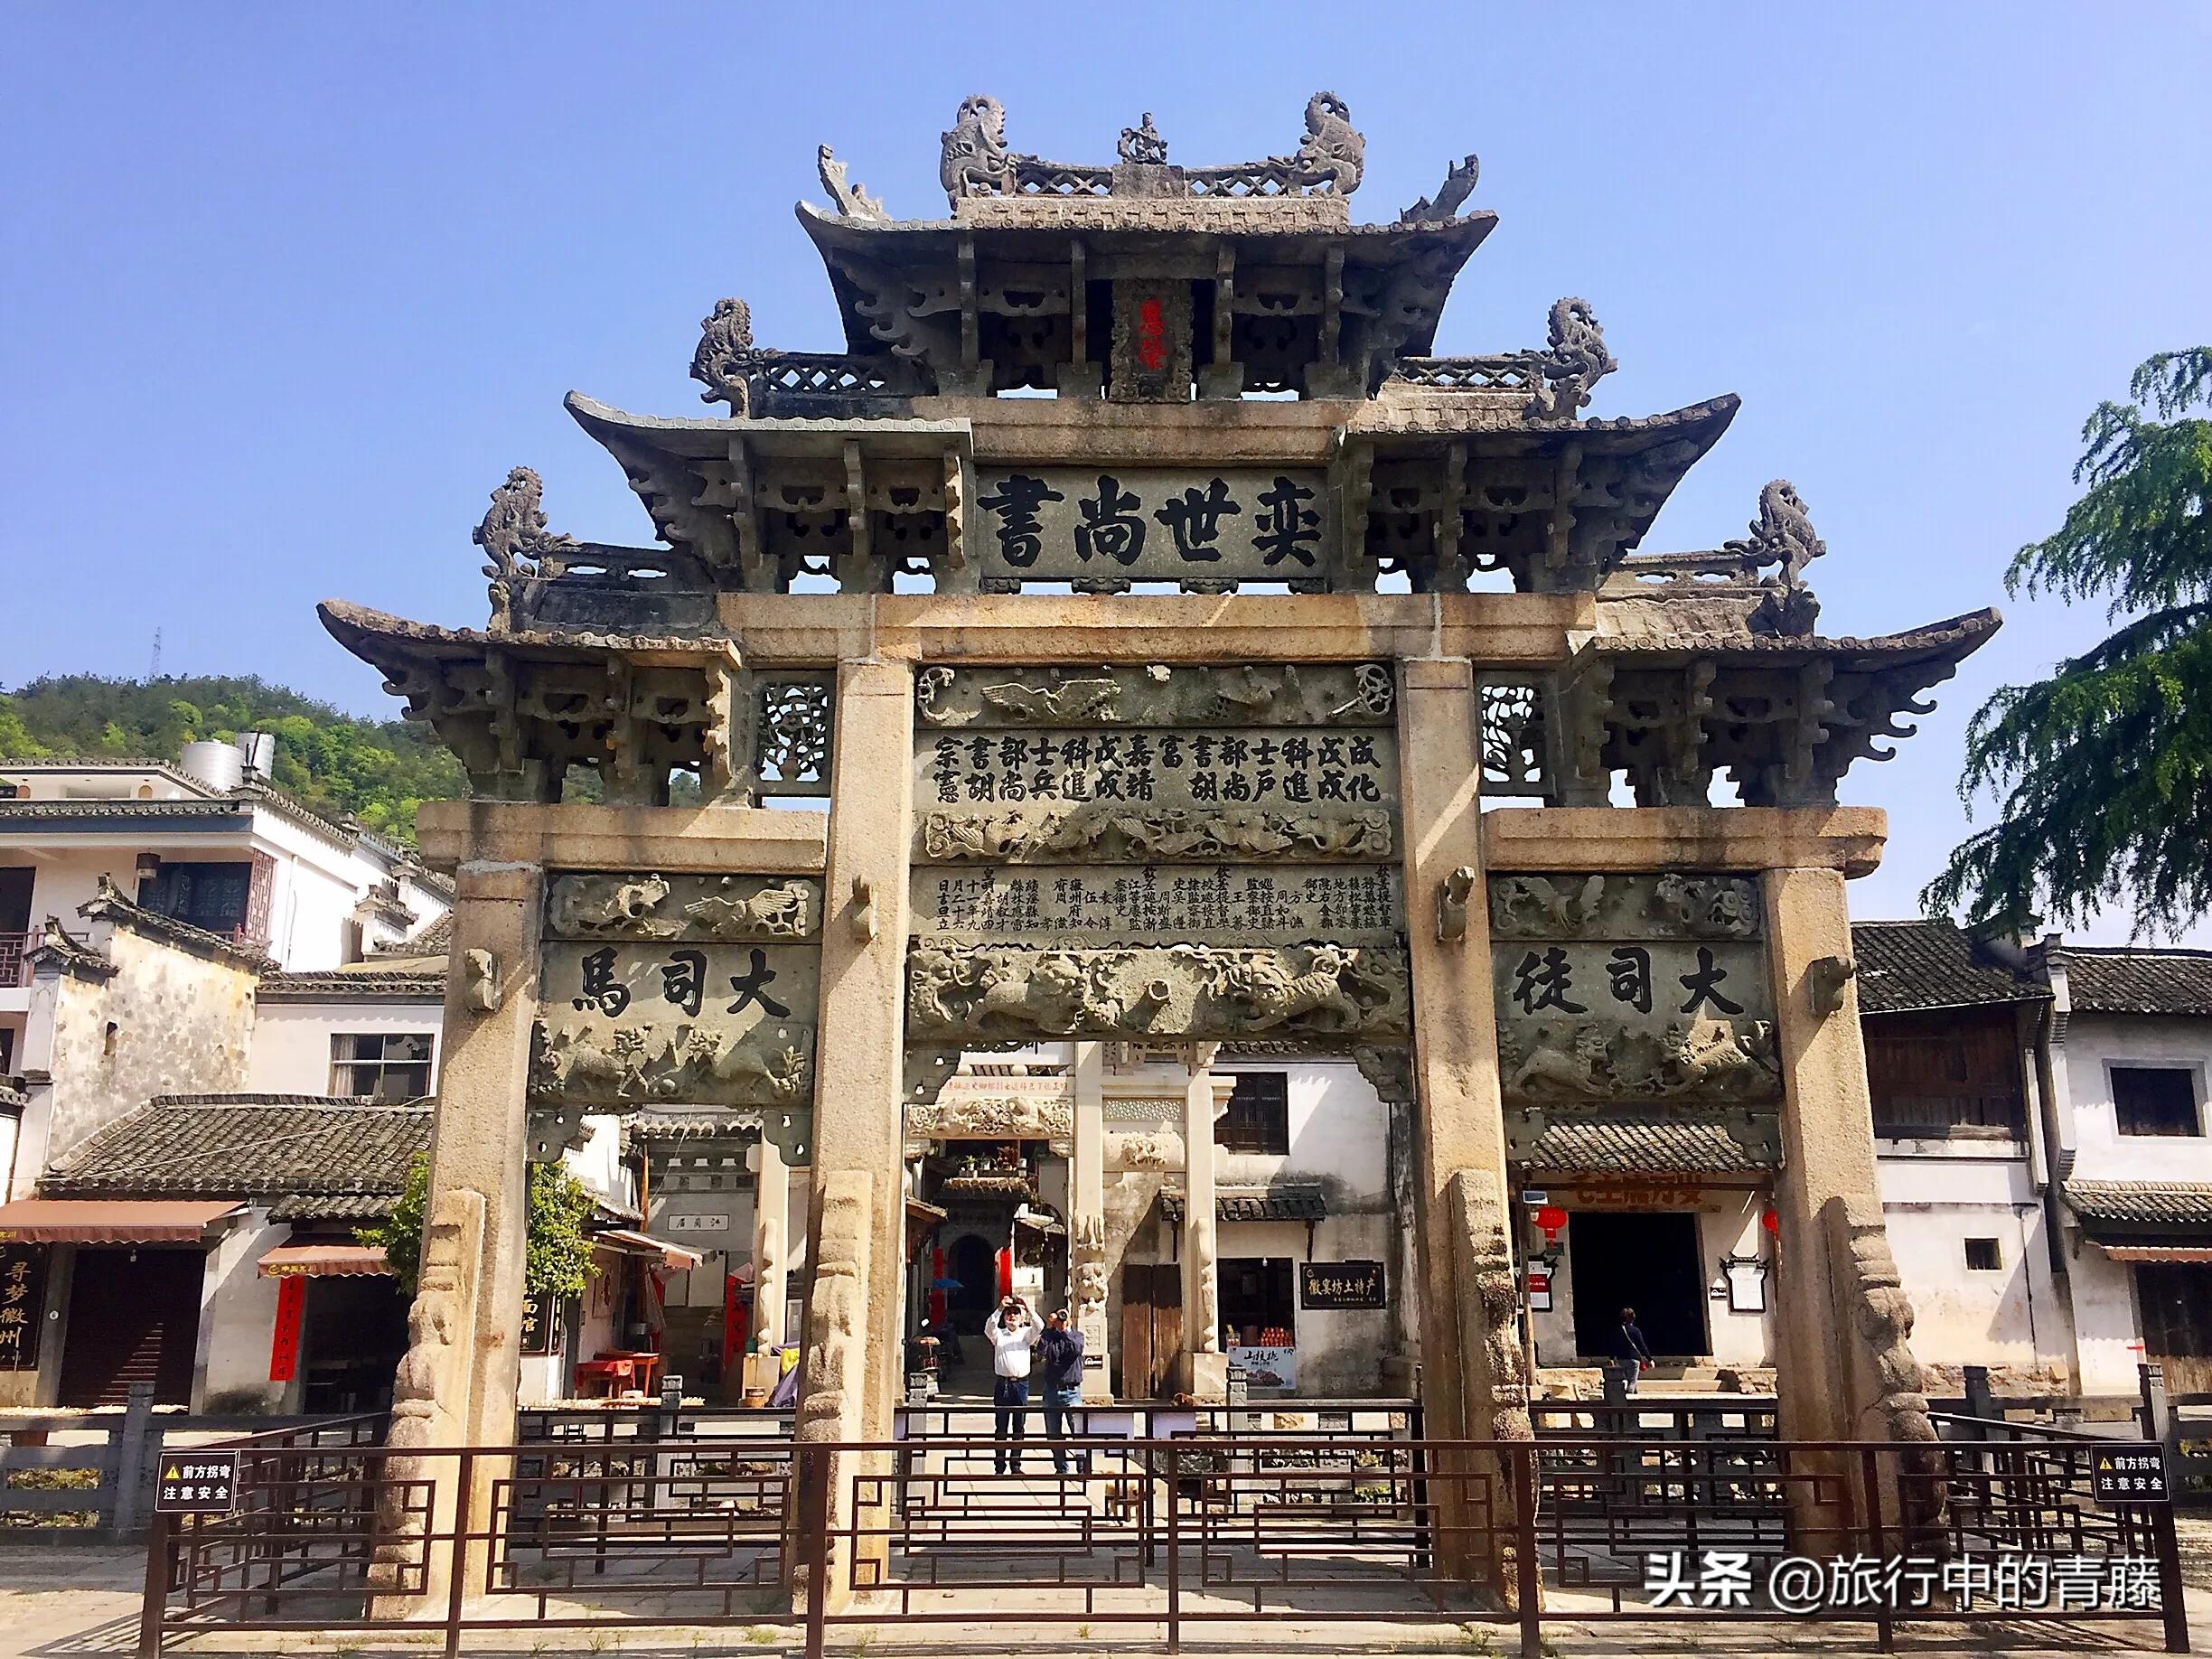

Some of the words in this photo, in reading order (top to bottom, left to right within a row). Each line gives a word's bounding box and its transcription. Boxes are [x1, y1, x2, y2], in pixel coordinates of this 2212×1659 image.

[2114, 1456, 2160, 1470] 前方拐弯
[183, 1464, 231, 1479] 前方拐弯
[2101, 1476, 2163, 1491] 注意安全
[164, 1486, 229, 1500] 注意安全
